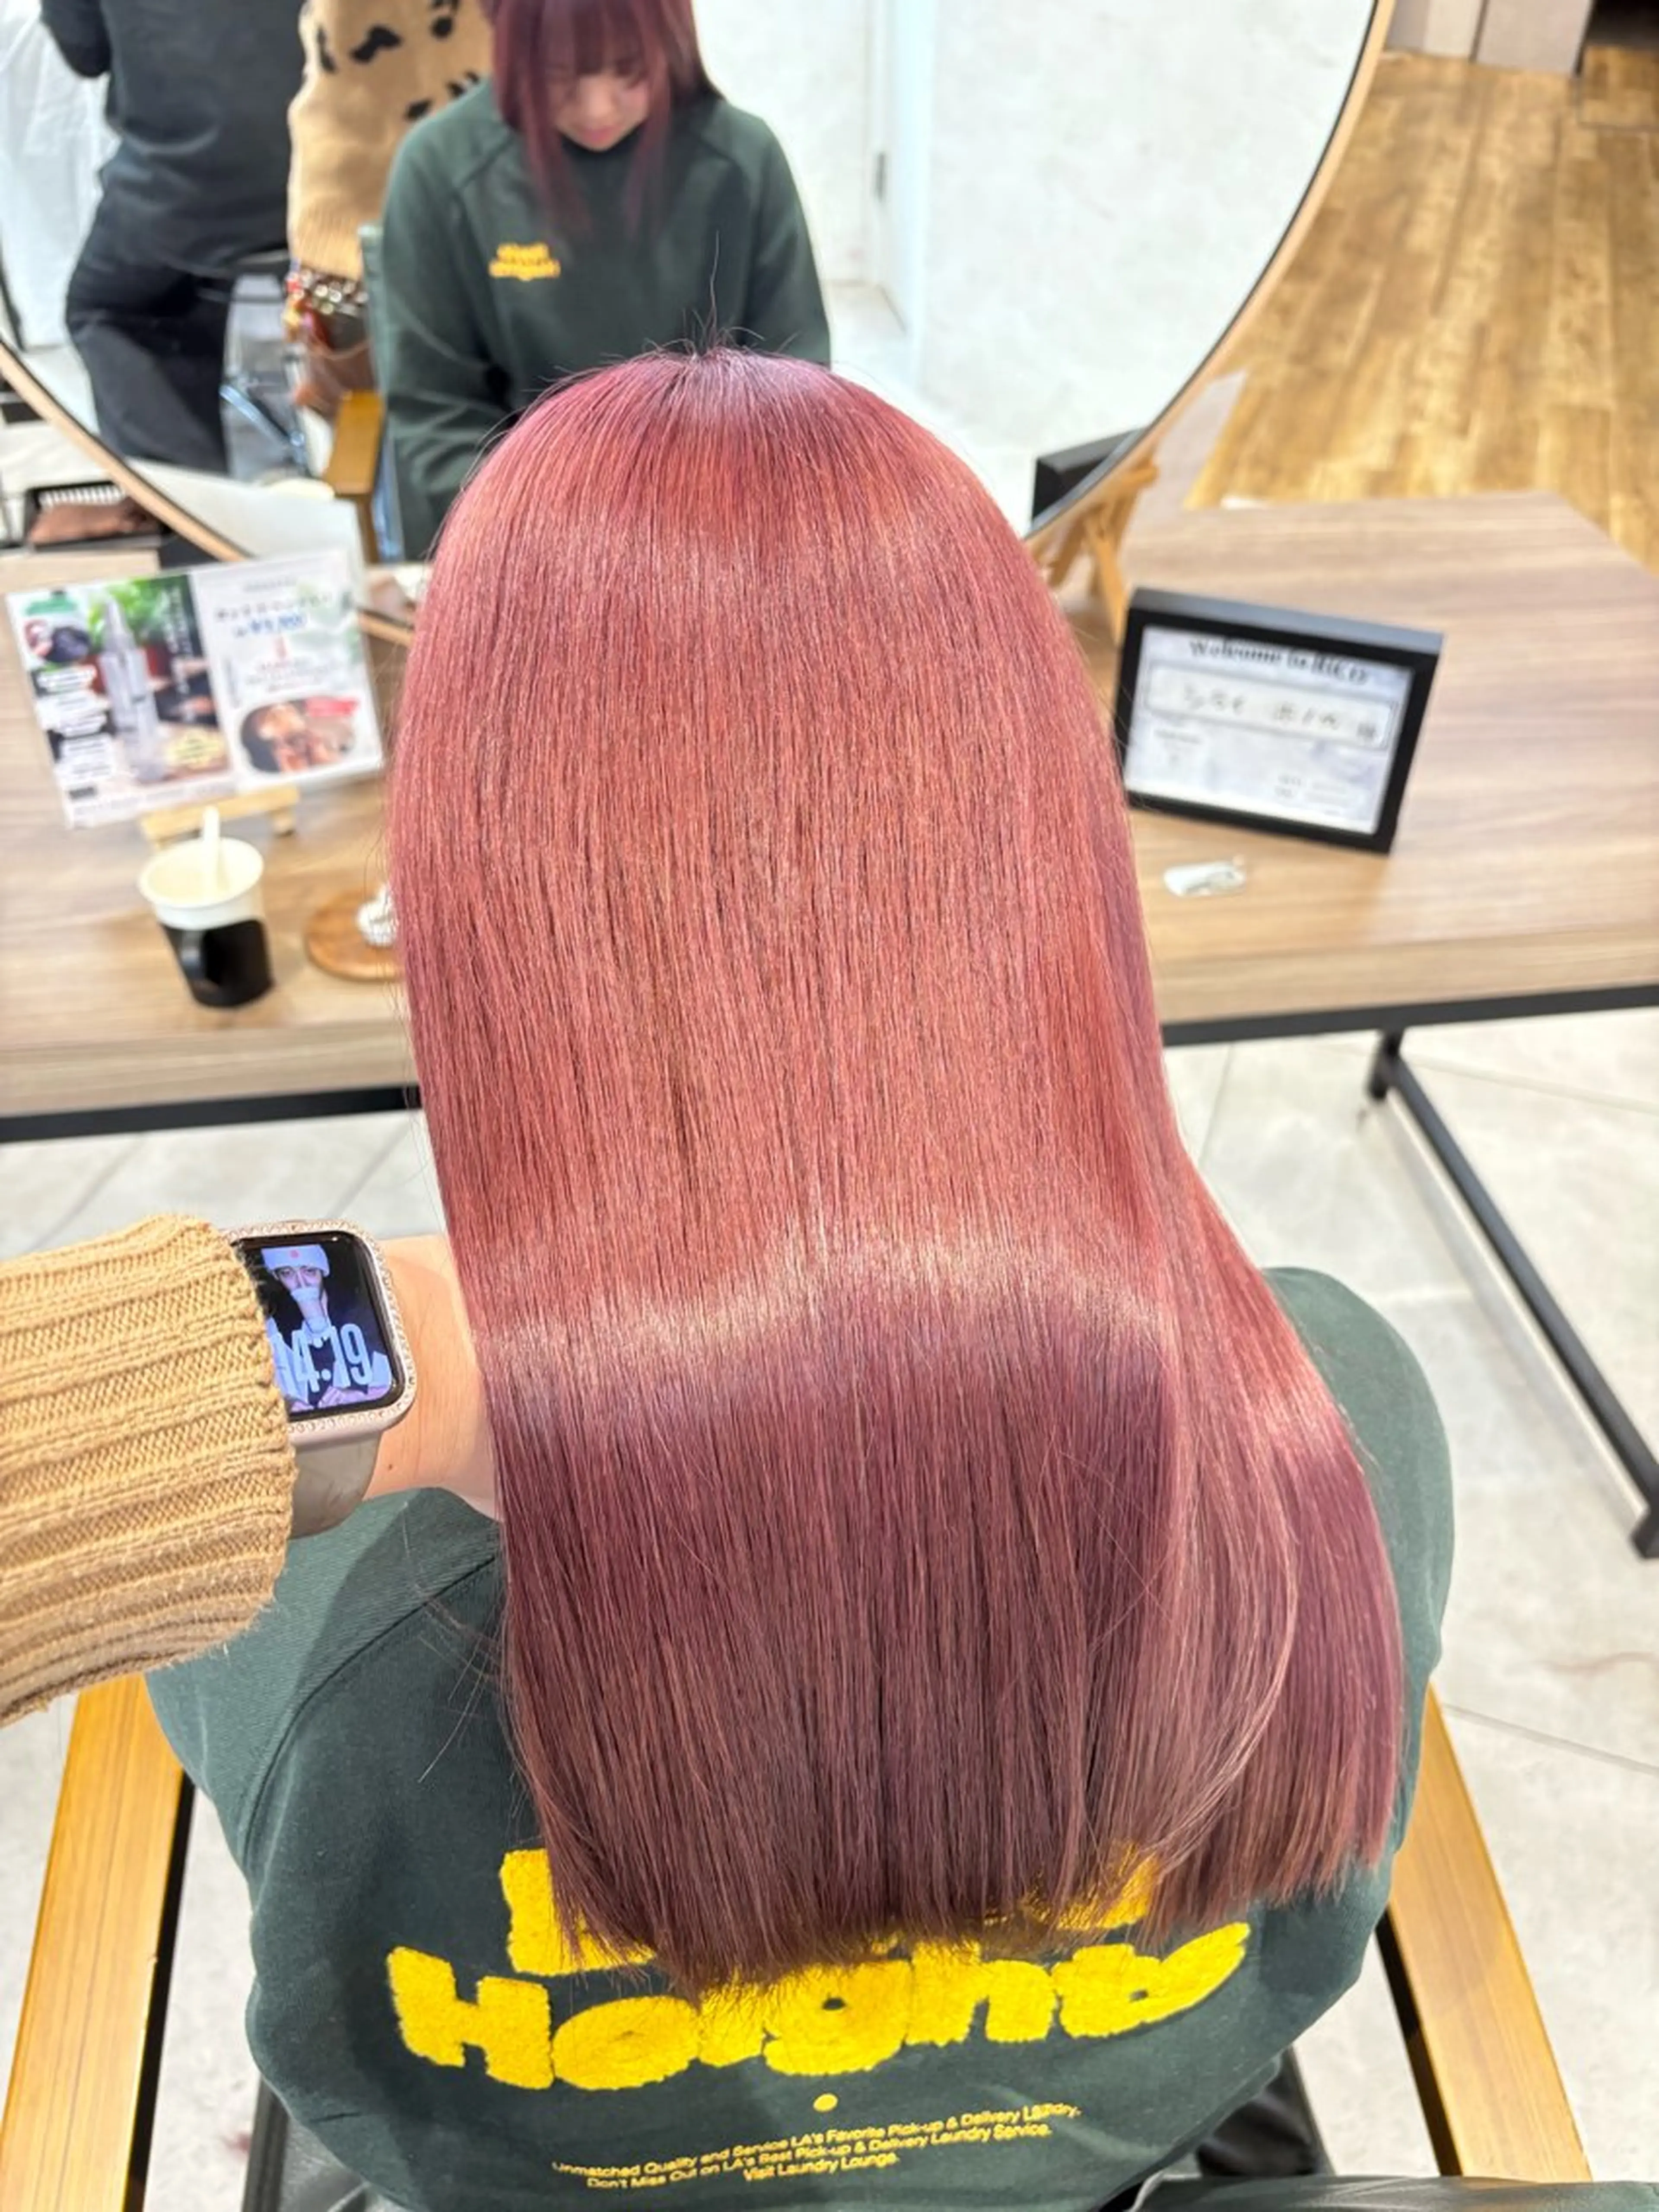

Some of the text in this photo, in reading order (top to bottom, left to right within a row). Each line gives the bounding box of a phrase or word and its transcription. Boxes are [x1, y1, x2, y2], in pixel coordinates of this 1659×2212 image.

[1189, 639, 1281, 666] Welcome
[269, 1323, 372, 1399] 14:19
[552, 2161, 641, 2178] Unmatched
[644, 2156, 697, 2173] Quality
[700, 2148, 730, 2164] and
[732, 2139, 788, 2157] Service
[791, 2133, 824, 2147] LA's
[826, 2126, 886, 2143] Favorite
[888, 2120, 944, 2136] Pick-up
[946, 2116, 959, 2131] &
[960, 2110, 1021, 2128] Delivery
[587, 2177, 628, 2188] Don't
[630, 2175, 667, 2188] Miss
[669, 2168, 697, 2181] Out
[699, 2164, 720, 2176] on
[722, 2157, 756, 2171] LA's
[759, 2150, 792, 2164] Best
[795, 2144, 852, 2159] Pick-up
[853, 2140, 866, 2155] &
[868, 2136, 929, 2152] Delivery
[930, 2126, 992, 2145] Laundry
[743, 2165, 775, 2181] Visit
[778, 2158, 839, 2177] Laundry
